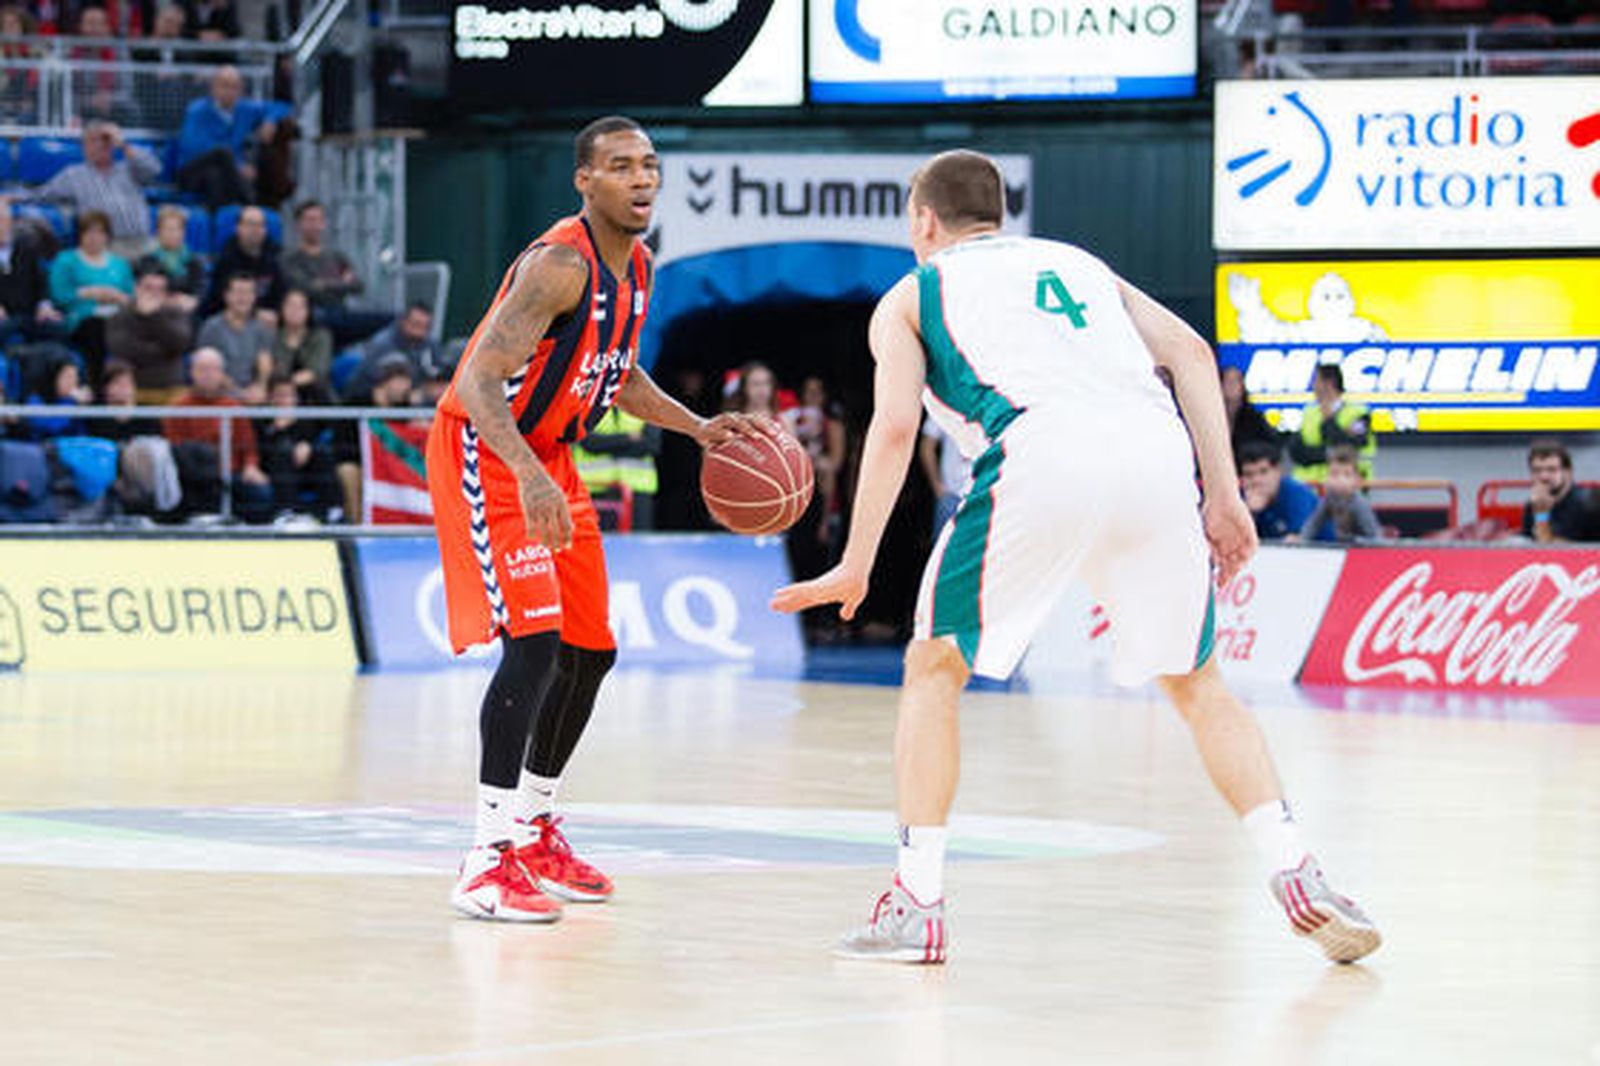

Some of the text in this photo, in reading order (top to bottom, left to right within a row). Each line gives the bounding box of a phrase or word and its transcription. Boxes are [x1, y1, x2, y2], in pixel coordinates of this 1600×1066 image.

[942, 5, 1176, 39] GALDIANO
[1355, 95, 1526, 148] radio
[731, 164, 911, 218] humm
[1355, 157, 1568, 209] vitoria
[1034, 270, 1087, 329] 4
[37, 586, 339, 635] SEGURIDAD
